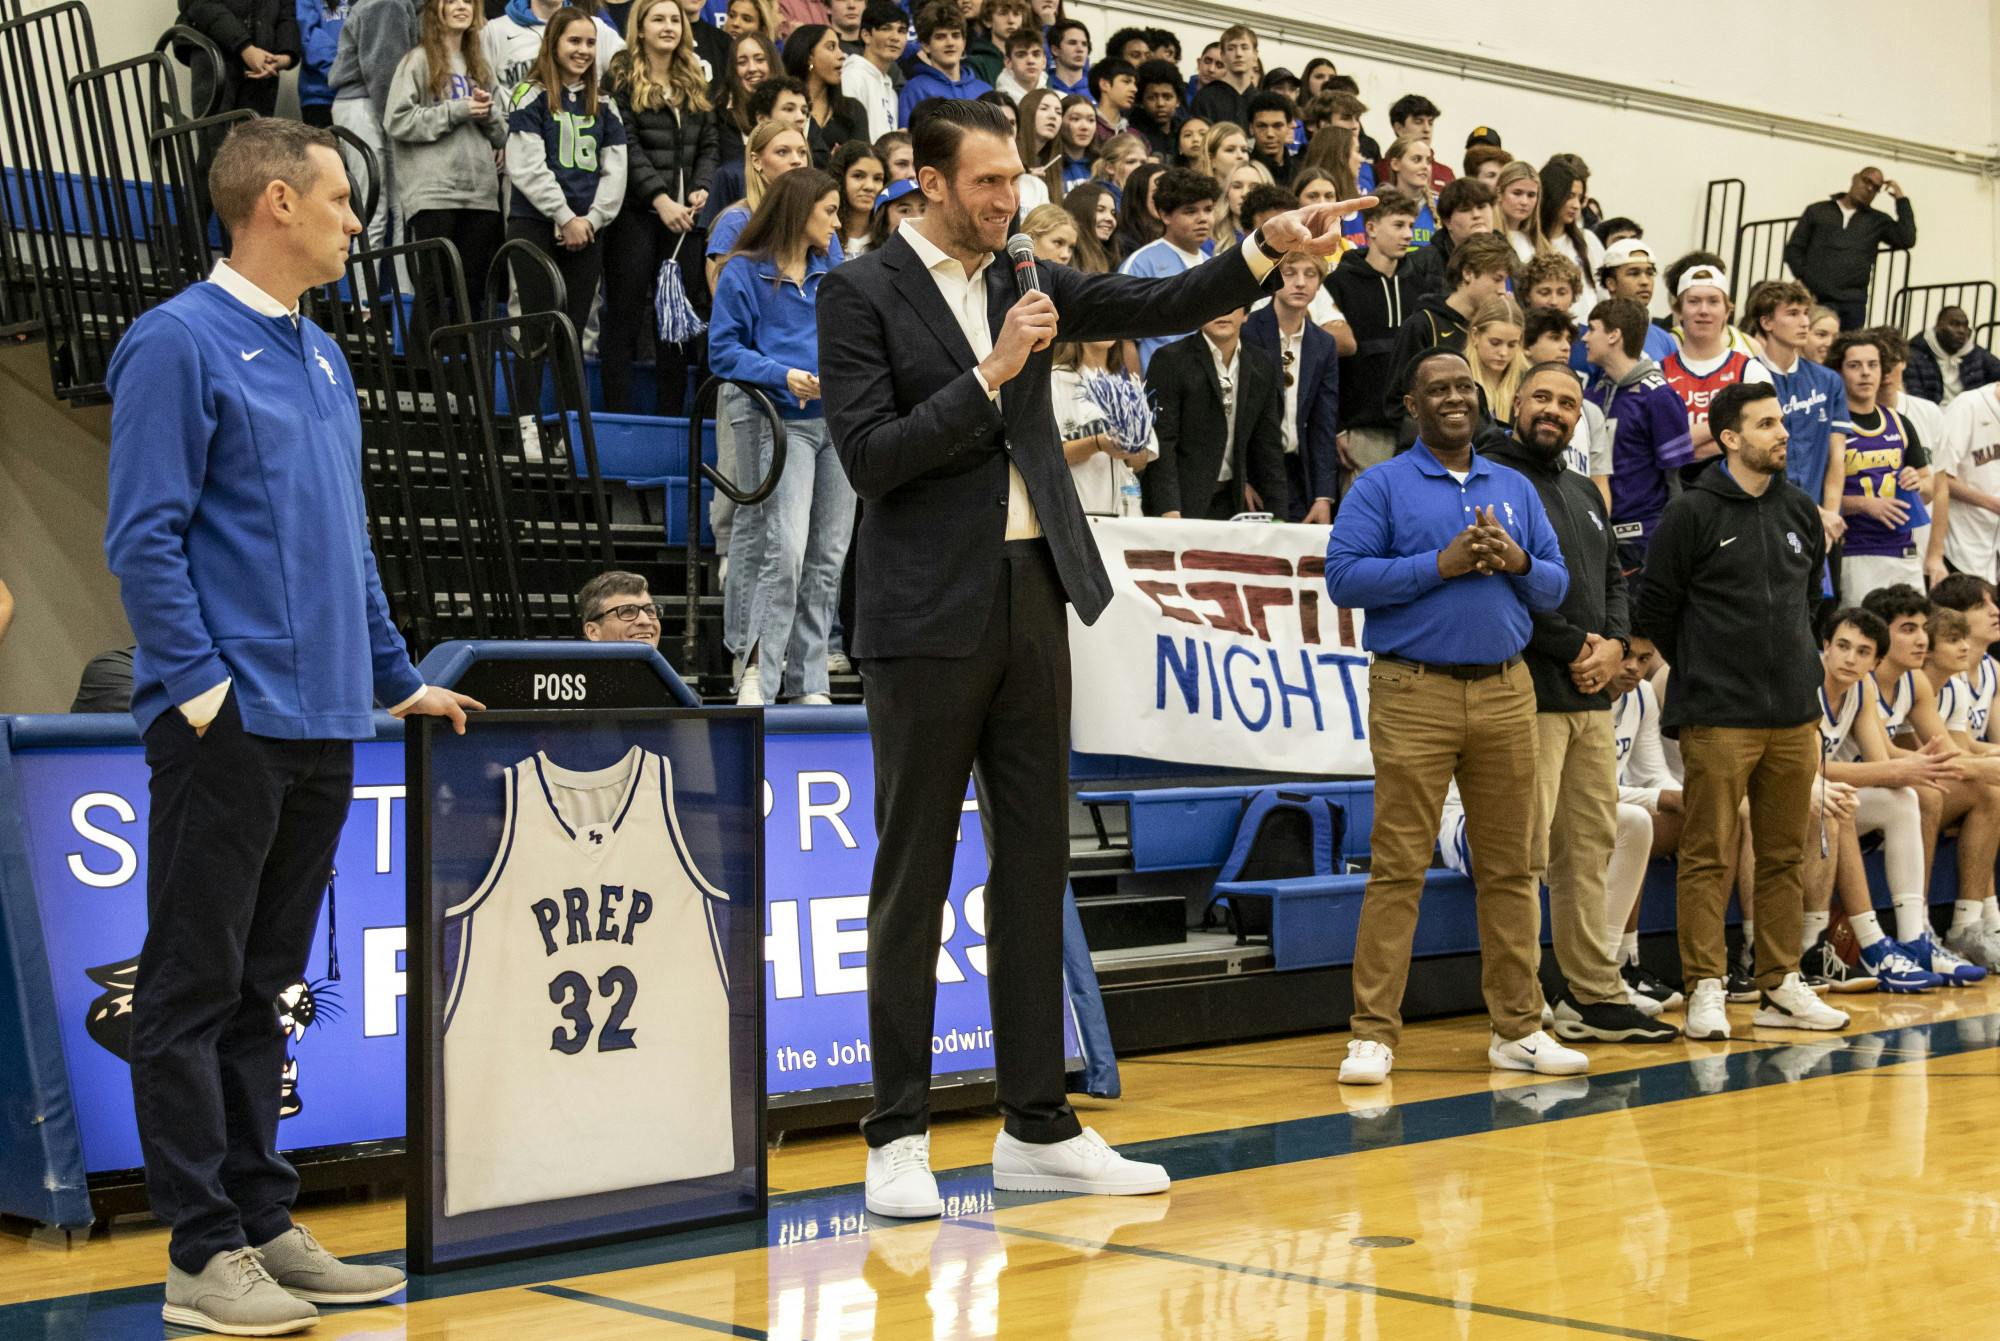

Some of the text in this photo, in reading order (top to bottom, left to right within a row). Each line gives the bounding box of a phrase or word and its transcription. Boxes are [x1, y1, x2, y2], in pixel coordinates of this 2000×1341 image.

[553, 111, 598, 172] 16
[533, 673, 587, 701] POSS
[1155, 633, 1370, 740] NIGHT
[530, 883, 654, 957] PREP
[548, 965, 638, 1056] 32
[776, 1025, 994, 1072] the Joh odwi
